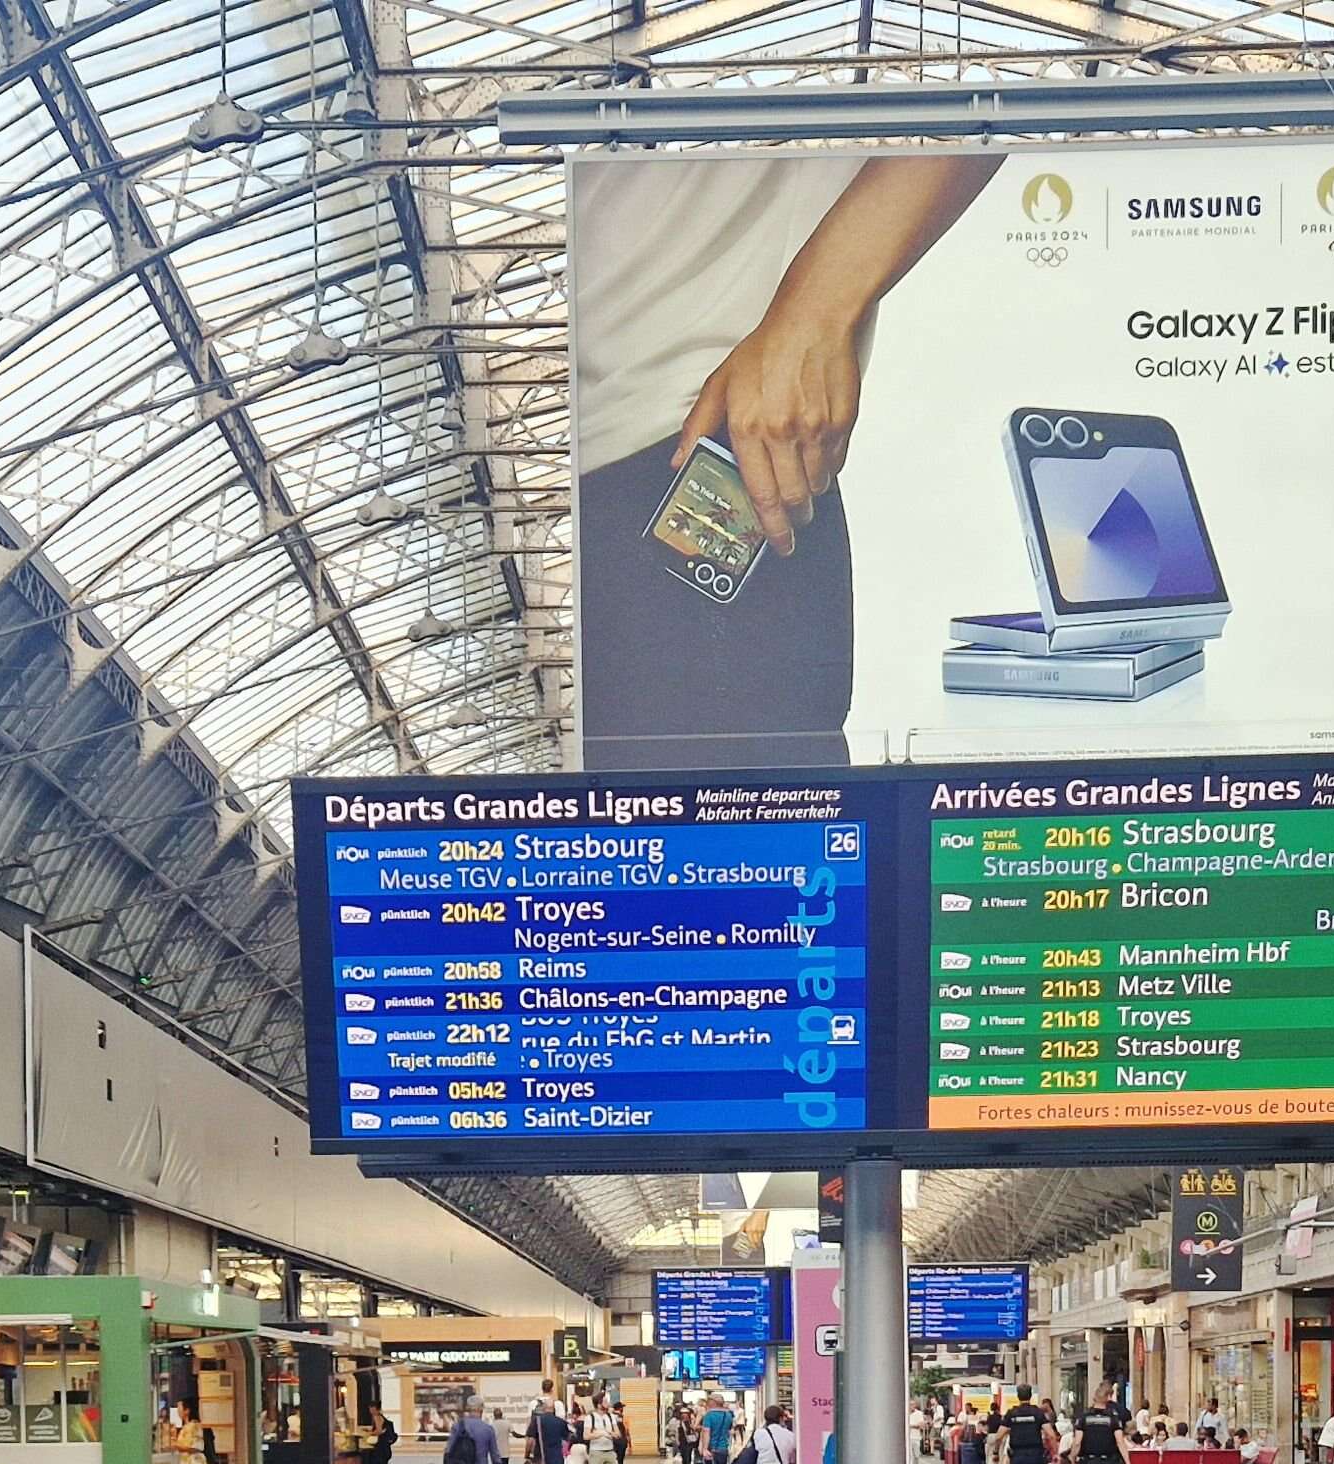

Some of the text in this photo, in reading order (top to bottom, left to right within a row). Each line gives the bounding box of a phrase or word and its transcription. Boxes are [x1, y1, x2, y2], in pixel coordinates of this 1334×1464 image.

[1127, 196, 1262, 220] SAMSUNG
[1006, 231, 1089, 242] PARIS 2024
[1131, 226, 1257, 238] PARTENAIRE MONDIAL
[1127, 308, 1259, 345] Galaxy
[1266, 307, 1284, 335] Z
[1135, 355, 1227, 383] Galaxy
[1235, 353, 1257, 376] AI
[696, 788, 841, 805] Mainline departures
[930, 775, 1301, 810] Arrivées Grandes Lignes
[325, 791, 683, 828] Départs Grandes Lignes
[696, 805, 842, 821] Abfahrt Fernverkehr
[982, 828, 1016, 840] retard
[1045, 818, 1276, 848] 20h16 Strasbourg
[378, 832, 856, 864] pünktlich 20h24 Strasbourg 26
[380, 862, 806, 889] Meuse TGV Lorraine TGV Strasbourg
[983, 854, 1108, 880] Strasbourg
[1043, 888, 1110, 910] 20h17
[1121, 882, 1208, 909] Bricon
[381, 896, 605, 927] pünktlich 20h42 Troyes
[515, 923, 817, 953] Nogent-sur-Seine Romilly
[1042, 941, 1291, 968] 20h43 Mannheim Hbf
[444, 958, 587, 981] 20h58 Reims
[784, 867, 836, 1129] départs
[1042, 973, 1232, 998] 21h13 Metz Ville
[445, 986, 787, 1011] 21h36 Châlons-en-Champagne
[1041, 1006, 1192, 1031] 21h18 Troyes
[446, 1024, 511, 1044] 22h12
[1041, 1034, 1241, 1060] 21h23 Strasbourg
[387, 1048, 613, 1073] Trajet modifié Troyes
[449, 1078, 594, 1103] 05h42 Troyes
[1040, 1066, 1187, 1090] 21h31 Nancy
[450, 1106, 652, 1129] 06h36 Saint-Dizier
[978, 1104, 1032, 1120] Fortes
[1037, 1103, 1109, 1119] chaleurs
[1125, 1101, 1252, 1118] munissez-vous
[1258, 1098, 1279, 1114] de
